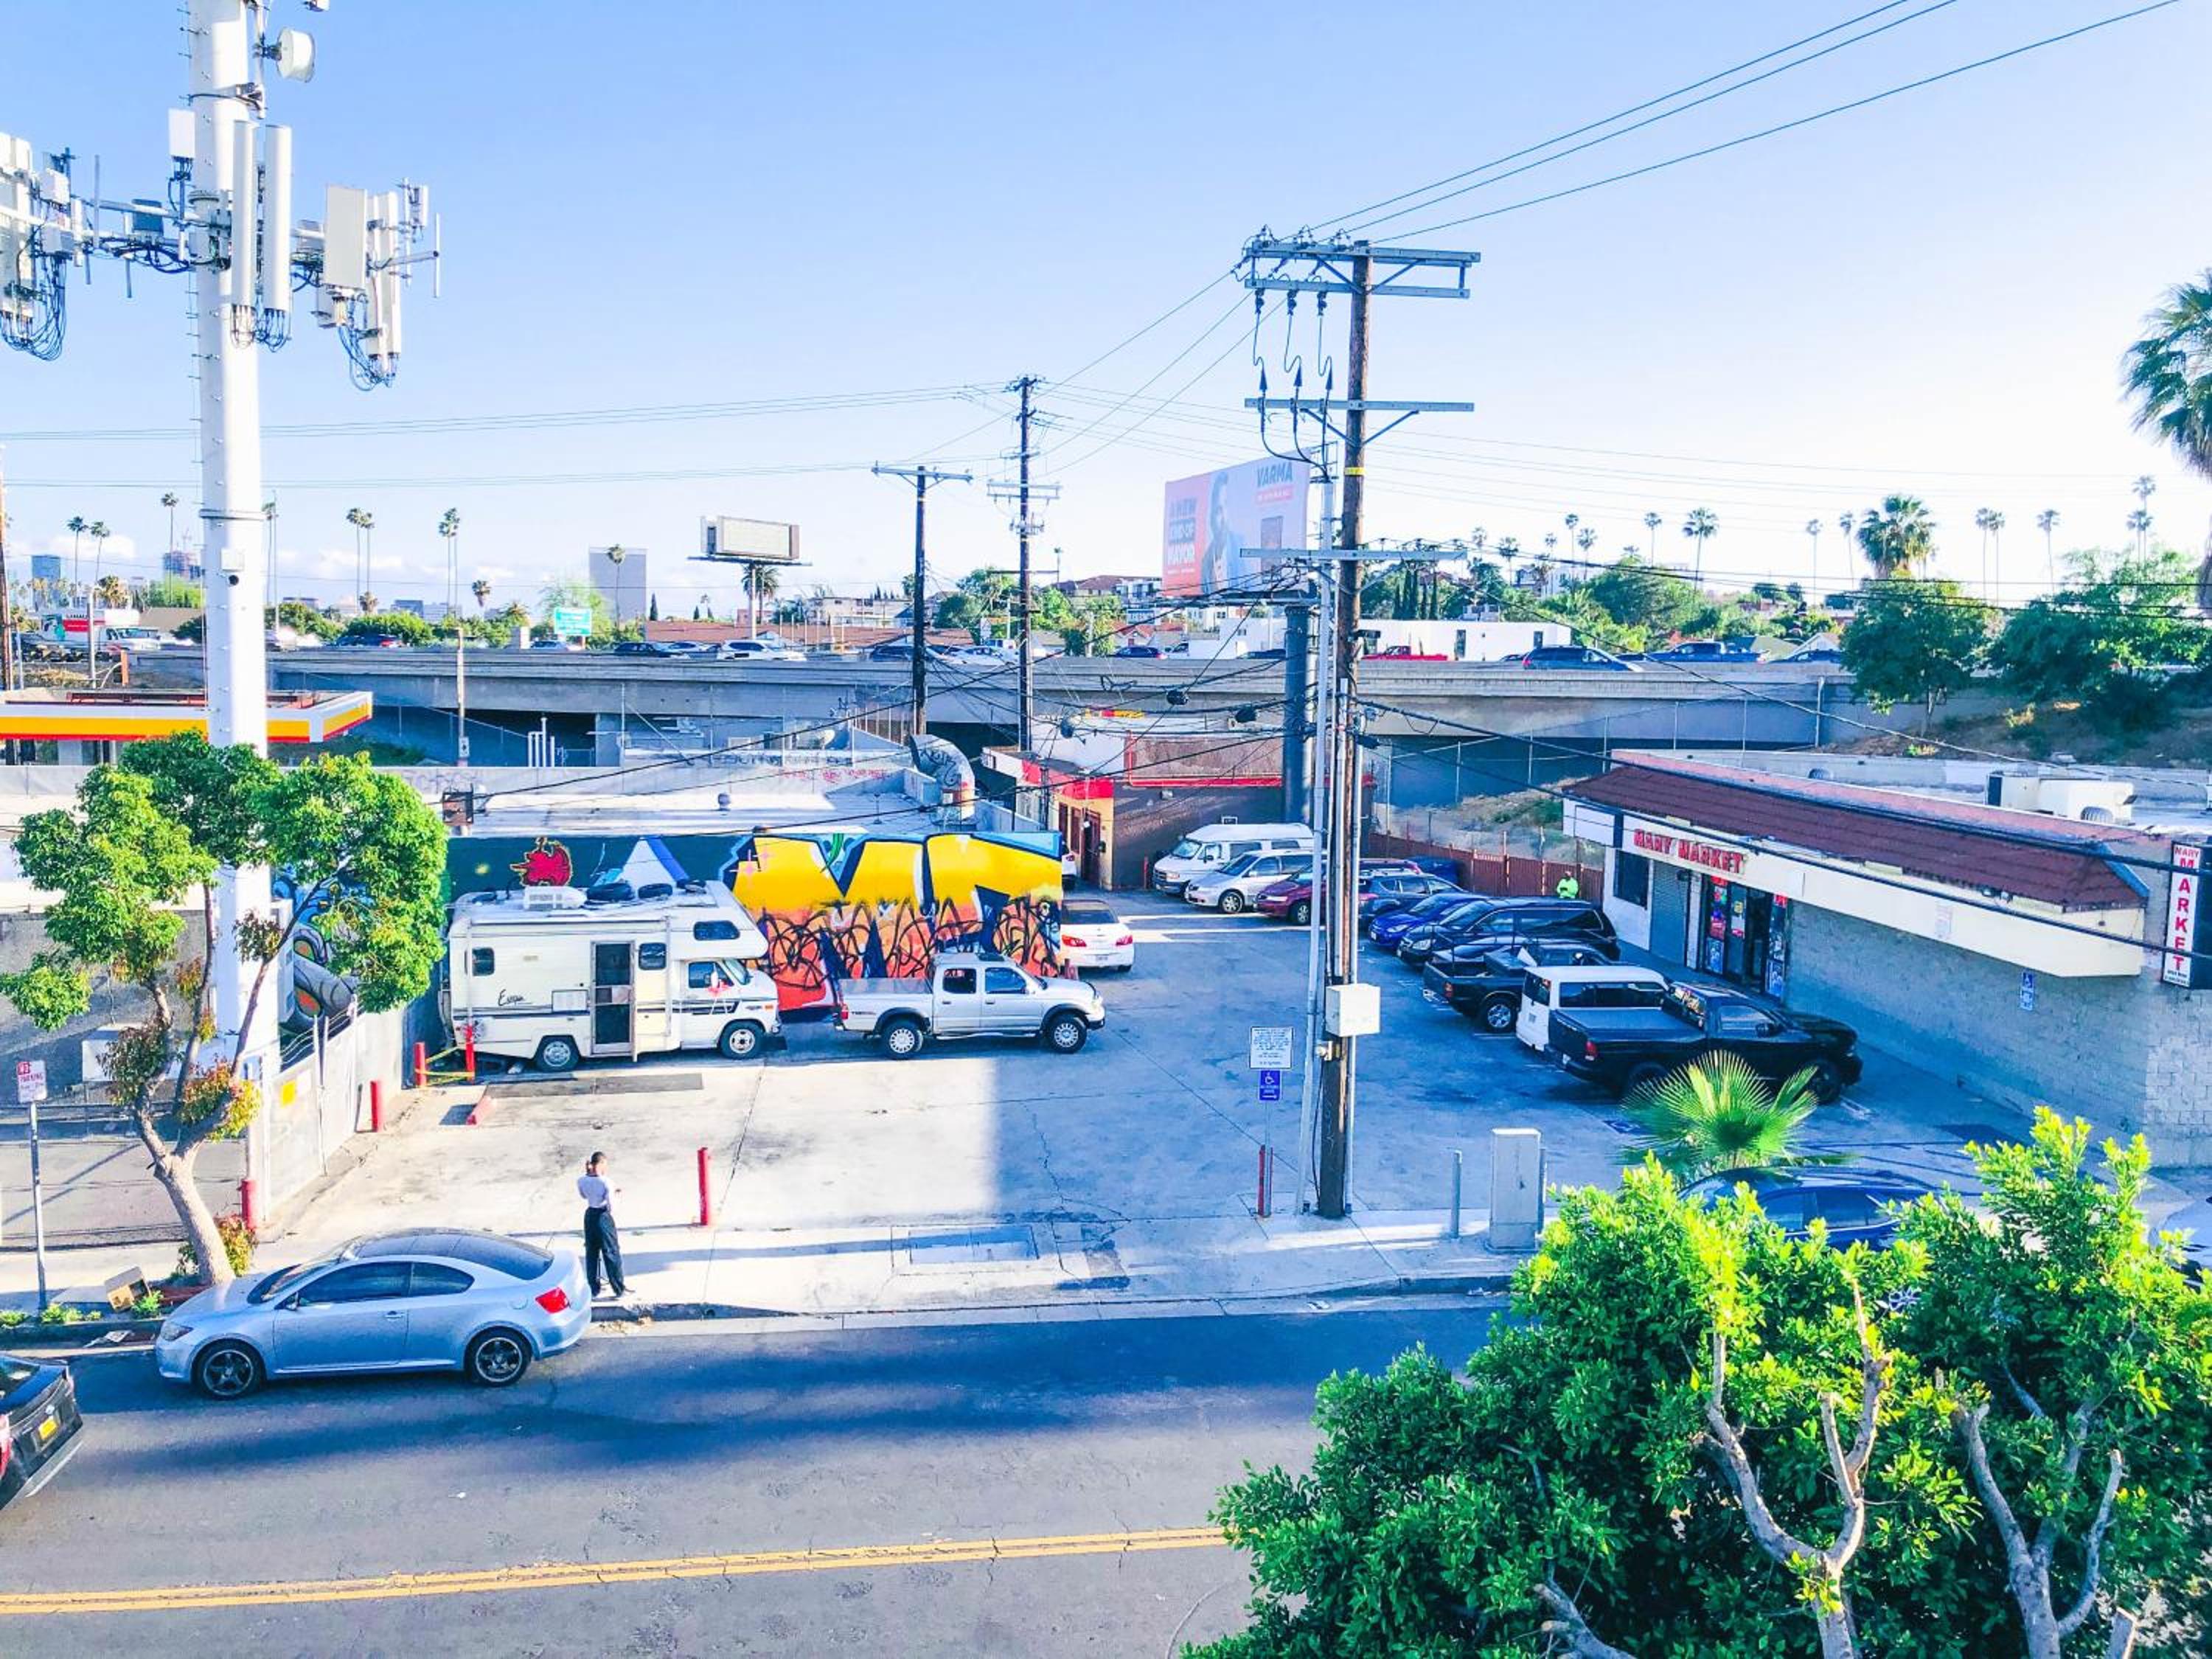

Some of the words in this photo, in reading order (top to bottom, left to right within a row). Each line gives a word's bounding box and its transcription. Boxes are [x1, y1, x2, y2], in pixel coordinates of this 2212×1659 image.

[1257, 462, 1293, 487] VARMA
[1633, 828, 1672, 854] MARY
[1677, 838, 1743, 873] MARKET
[2174, 846, 2199, 858] MARY
[2172, 858, 2195, 970] MARKET
